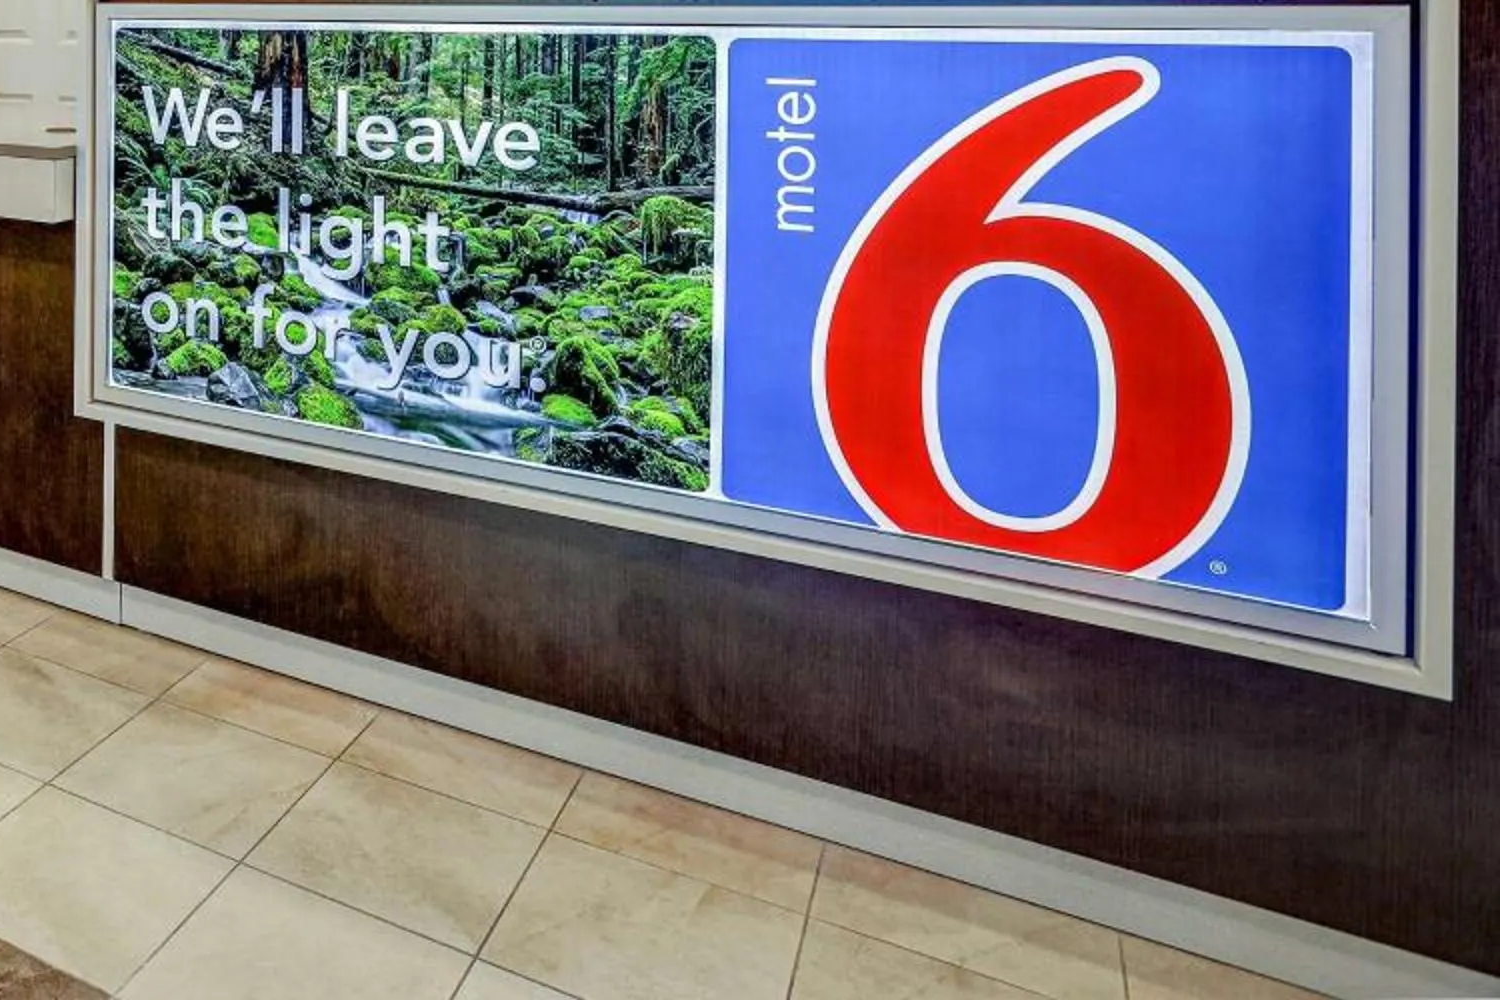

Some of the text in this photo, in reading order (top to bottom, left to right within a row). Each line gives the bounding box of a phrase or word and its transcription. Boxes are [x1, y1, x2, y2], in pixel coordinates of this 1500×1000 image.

[141, 86, 541, 171] We'll leave
[765, 76, 817, 233] motel
[141, 177, 451, 281] the light
[141, 289, 221, 341] on
[246, 283, 351, 360] for
[811, 56, 1252, 581] 6
